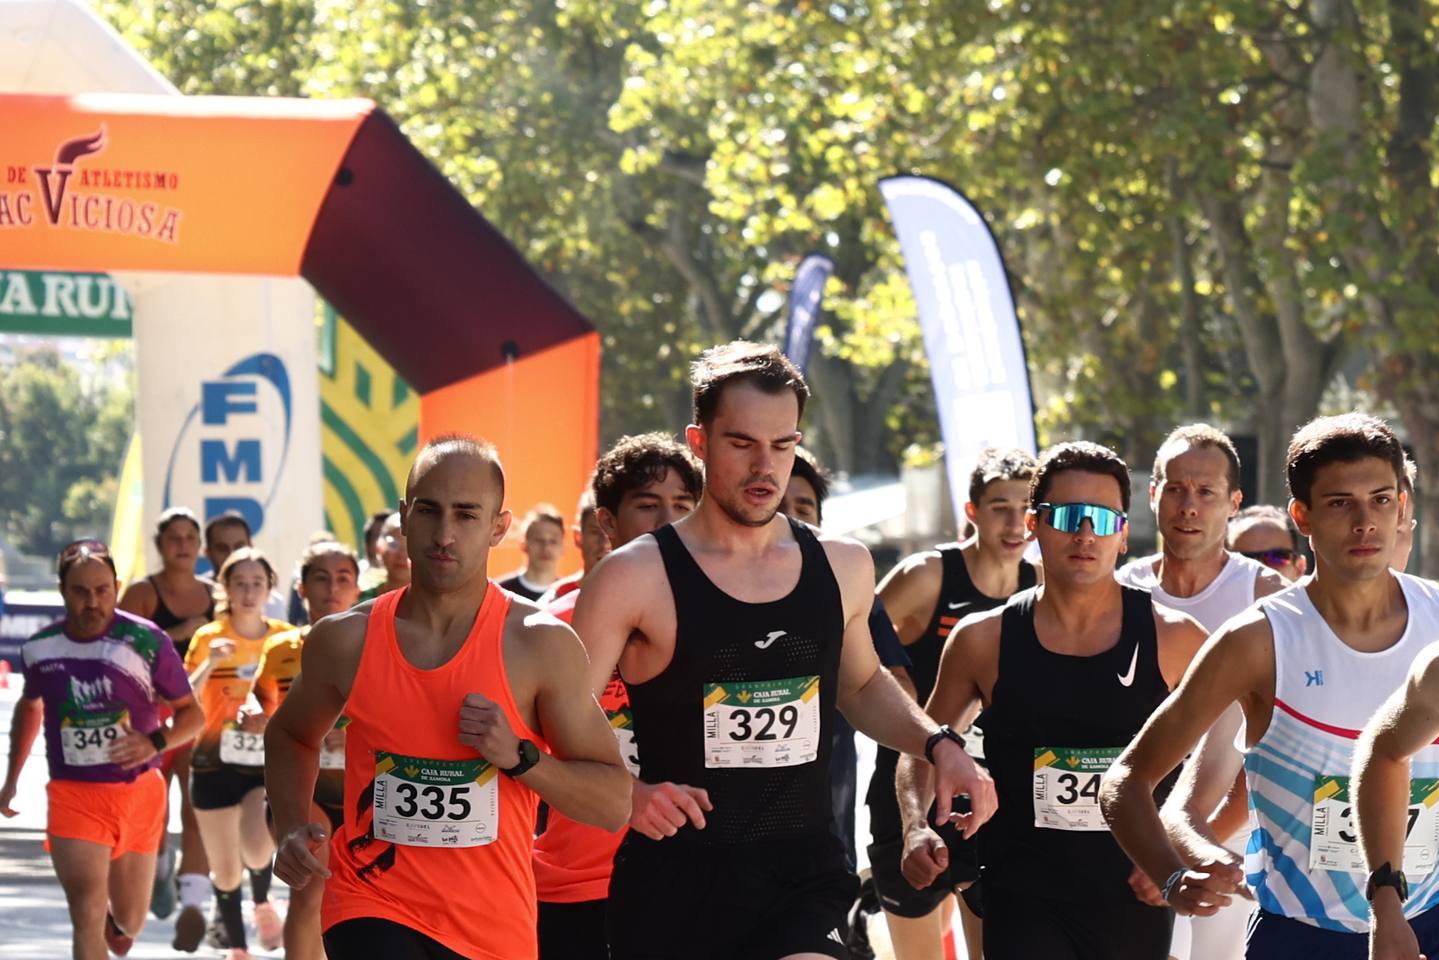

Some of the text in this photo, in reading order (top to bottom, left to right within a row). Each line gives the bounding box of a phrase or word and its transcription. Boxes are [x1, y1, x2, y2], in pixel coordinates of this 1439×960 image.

[7, 166, 179, 190] DE ATLETISMO
[706, 711, 717, 739] MILLA
[729, 705, 798, 741] 329
[233, 733, 265, 751] 32
[440, 768, 465, 778] RURAL
[1036, 773, 1046, 800] MILLA
[376, 780, 387, 809] MILLA
[395, 783, 472, 821] 335
[1056, 773, 1102, 805] 34
[1314, 806, 1327, 836] MILLA
